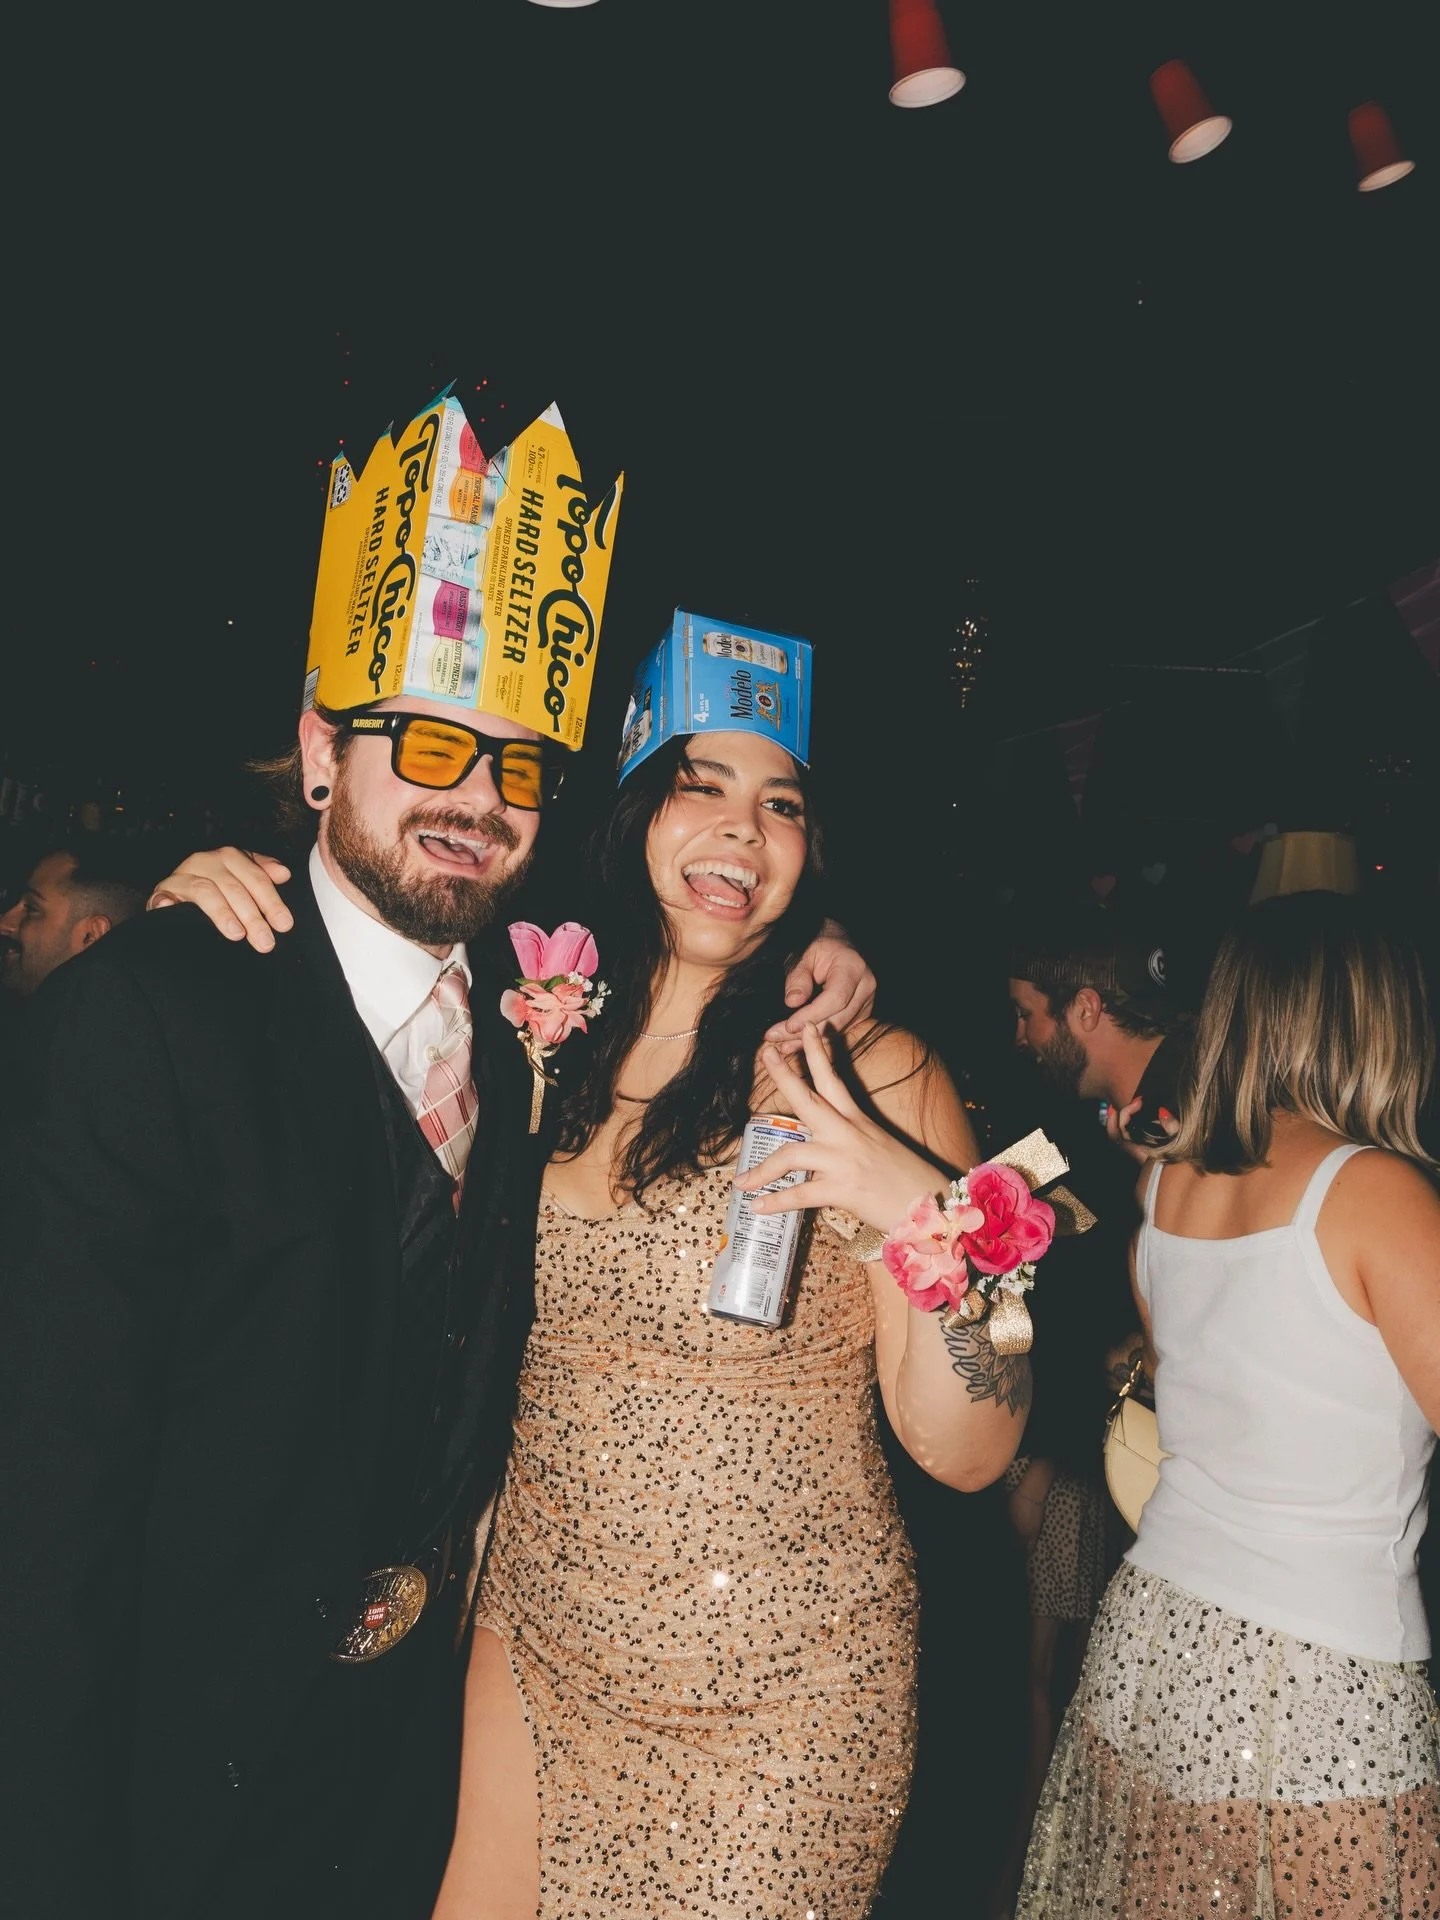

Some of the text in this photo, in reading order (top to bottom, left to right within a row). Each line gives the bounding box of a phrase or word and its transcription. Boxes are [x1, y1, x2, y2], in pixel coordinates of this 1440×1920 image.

[472, 476, 482, 503] TROPICAL
[345, 487, 390, 657] HARD SELTZER
[368, 413, 441, 694] Topo Chico
[490, 545, 499, 574] MINERALS
[493, 516, 512, 616] SPIKED SPARKLING WATER
[487, 582, 495, 600] TASTE
[502, 488, 546, 664] HARD SELTZER
[455, 590, 467, 632] OASIS CHERRY
[538, 474, 620, 732] Topo Chico
[448, 641, 462, 695] EXOTIC PINEAPPLE
[730, 669, 753, 719] Modelo
[352, 718, 385, 729] BURBERRY
[693, 711, 709, 722] 4
[366, 1614, 384, 1622] STAR
[368, 1607, 386, 1615] LONE
